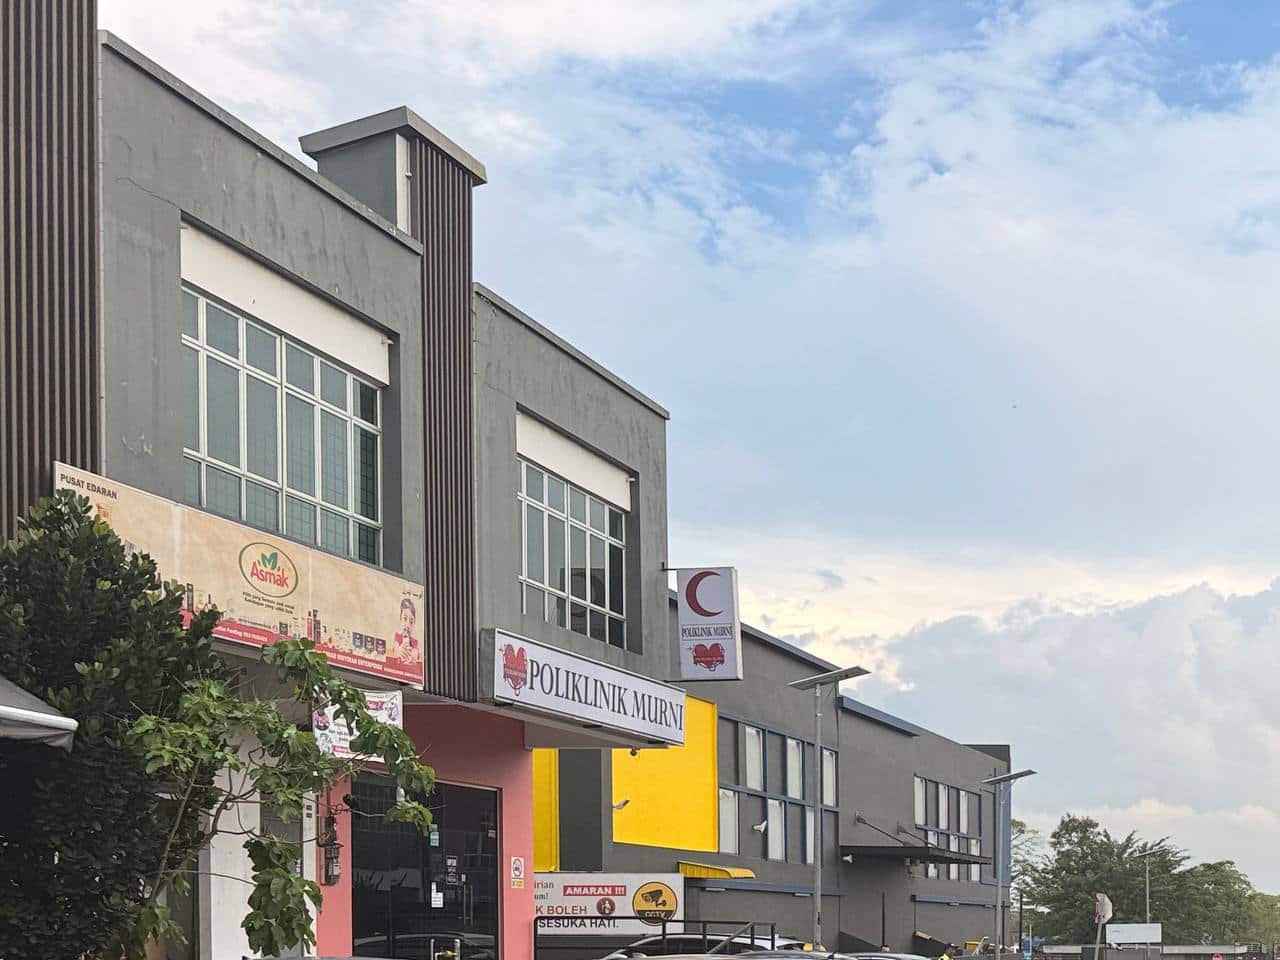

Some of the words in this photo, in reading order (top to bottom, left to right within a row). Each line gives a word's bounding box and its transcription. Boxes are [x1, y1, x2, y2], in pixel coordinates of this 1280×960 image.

[60, 473, 85, 489] PUSAT
[86, 483, 118, 499] EDARAN
[250, 560, 289, 589] Asmak
[682, 626, 713, 638] POLIKLINIK
[713, 625, 733, 637] MURNI
[528, 659, 628, 716] POLIKLINIK
[631, 690, 684, 731] MURNI
[565, 886, 612, 895] AMARAN
[615, 886, 625, 895] !!!
[547, 905, 587, 915] BOLEH
[539, 918, 588, 928] SESUKA
